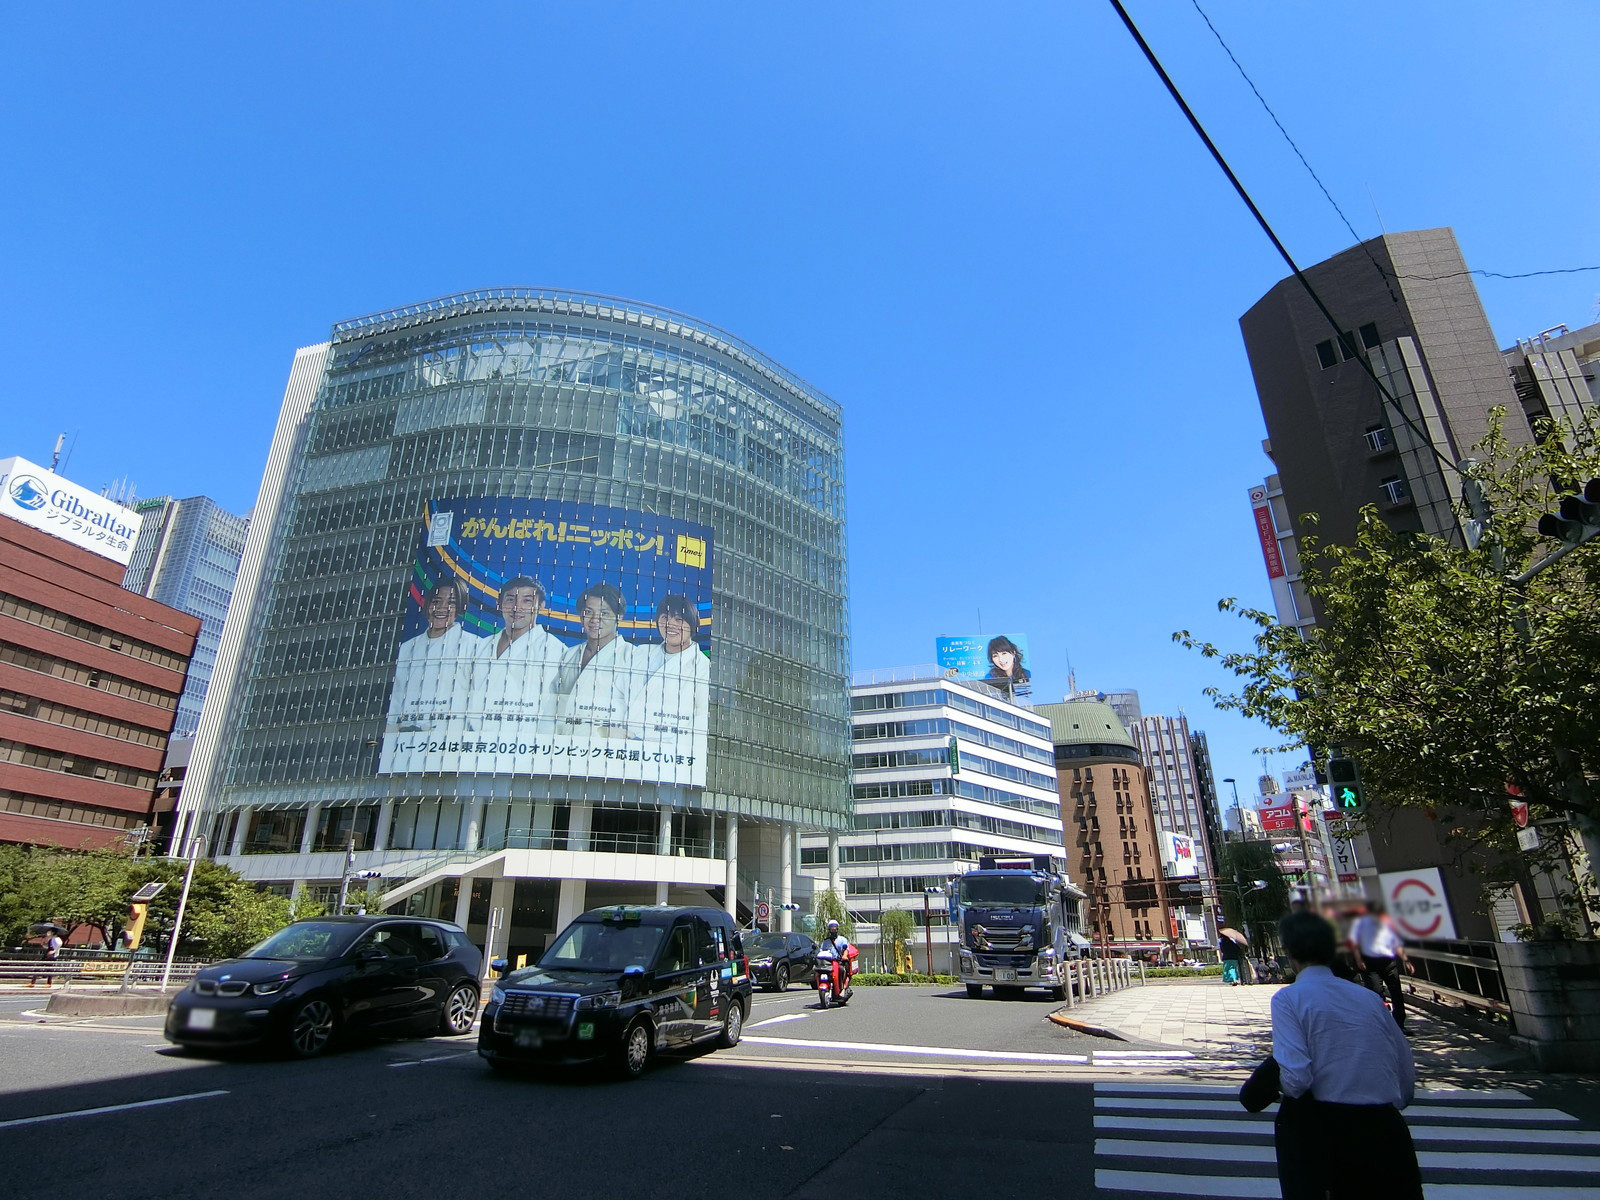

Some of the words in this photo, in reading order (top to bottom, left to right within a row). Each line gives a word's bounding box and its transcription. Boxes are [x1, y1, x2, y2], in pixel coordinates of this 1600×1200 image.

[46, 508, 129, 552] ジブラルタ生命
[51, 489, 136, 540] Gibraltar
[680, 546, 703, 557] Times
[393, 741, 696, 766] パーク24は東京2020オリンピックを応援しています
[1265, 808, 1291, 819] アコム
[1335, 835, 1349, 872] スシロー
